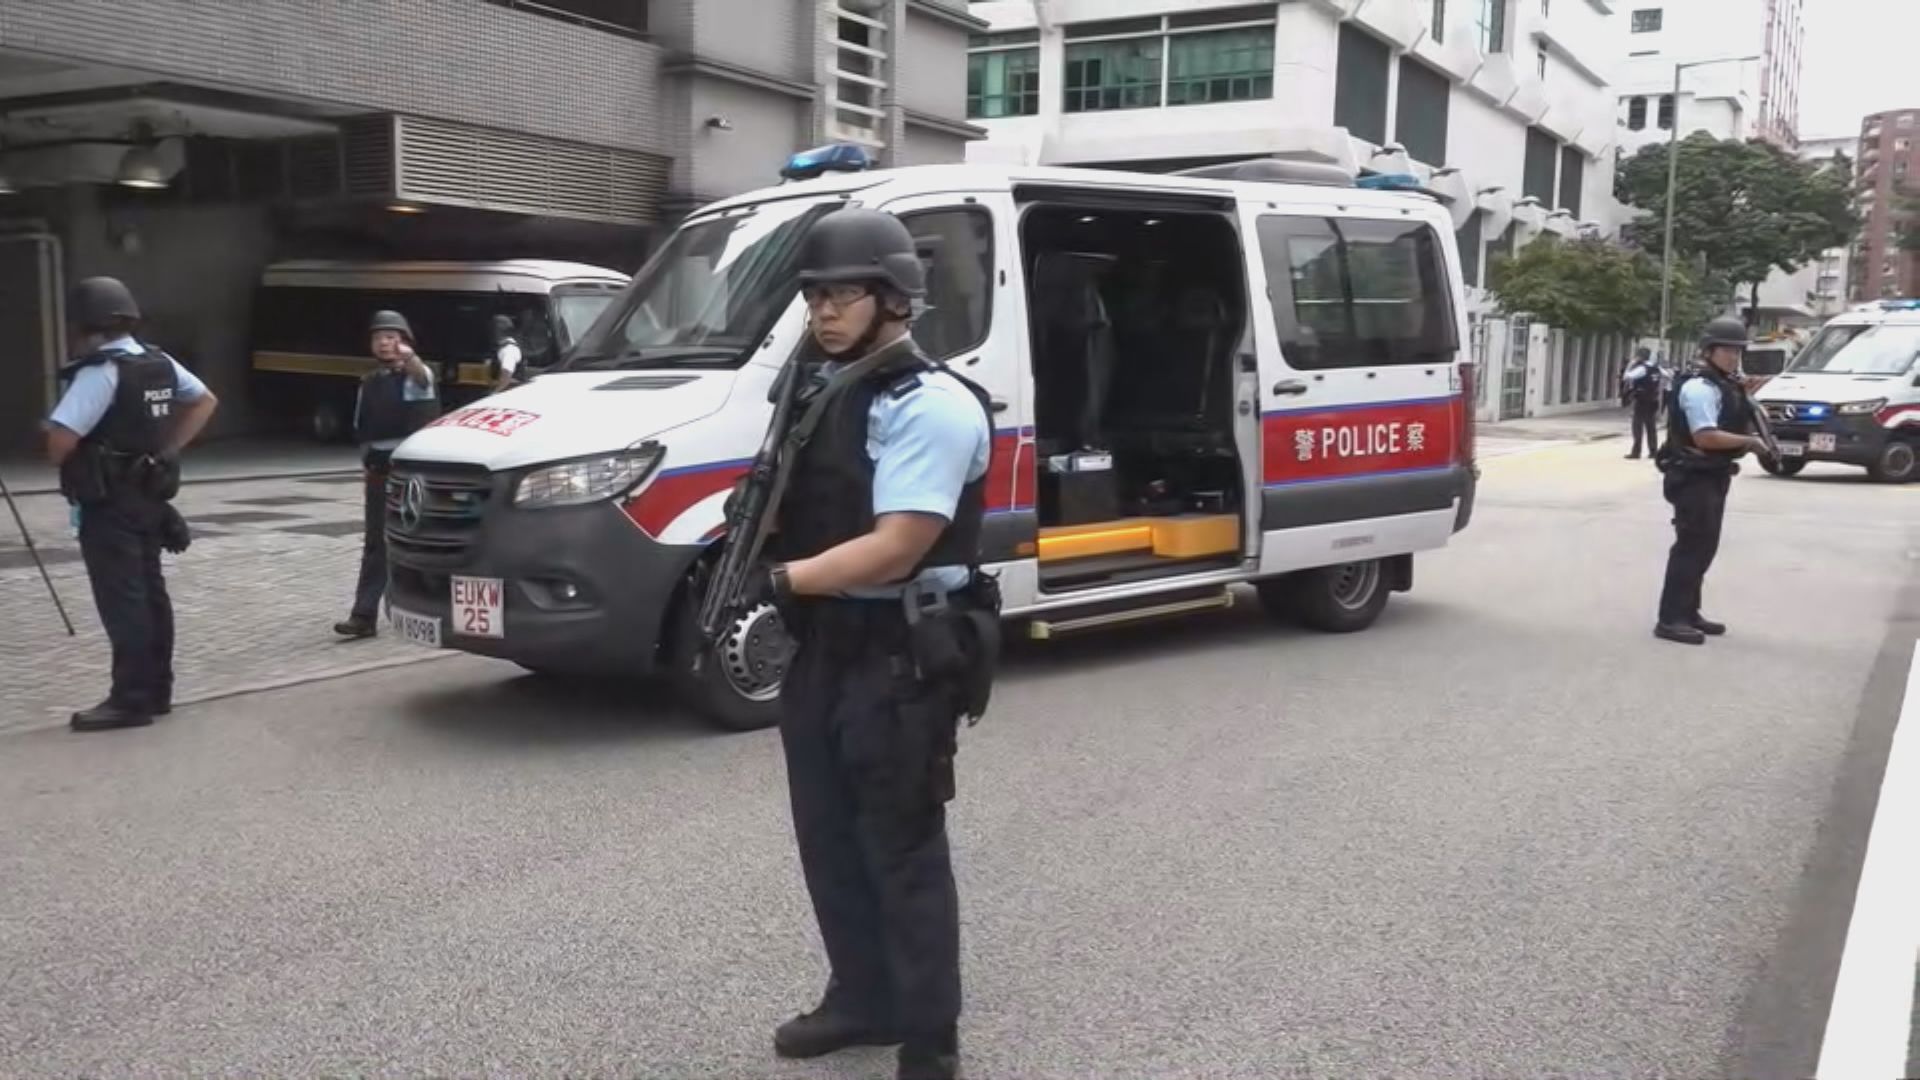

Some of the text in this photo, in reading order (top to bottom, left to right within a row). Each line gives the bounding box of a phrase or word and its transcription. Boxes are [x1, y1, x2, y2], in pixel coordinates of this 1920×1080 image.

[1295, 422, 1425, 461] 警 POLICE 察
[453, 579, 500, 608] EUKW
[462, 607, 491, 634] 25
